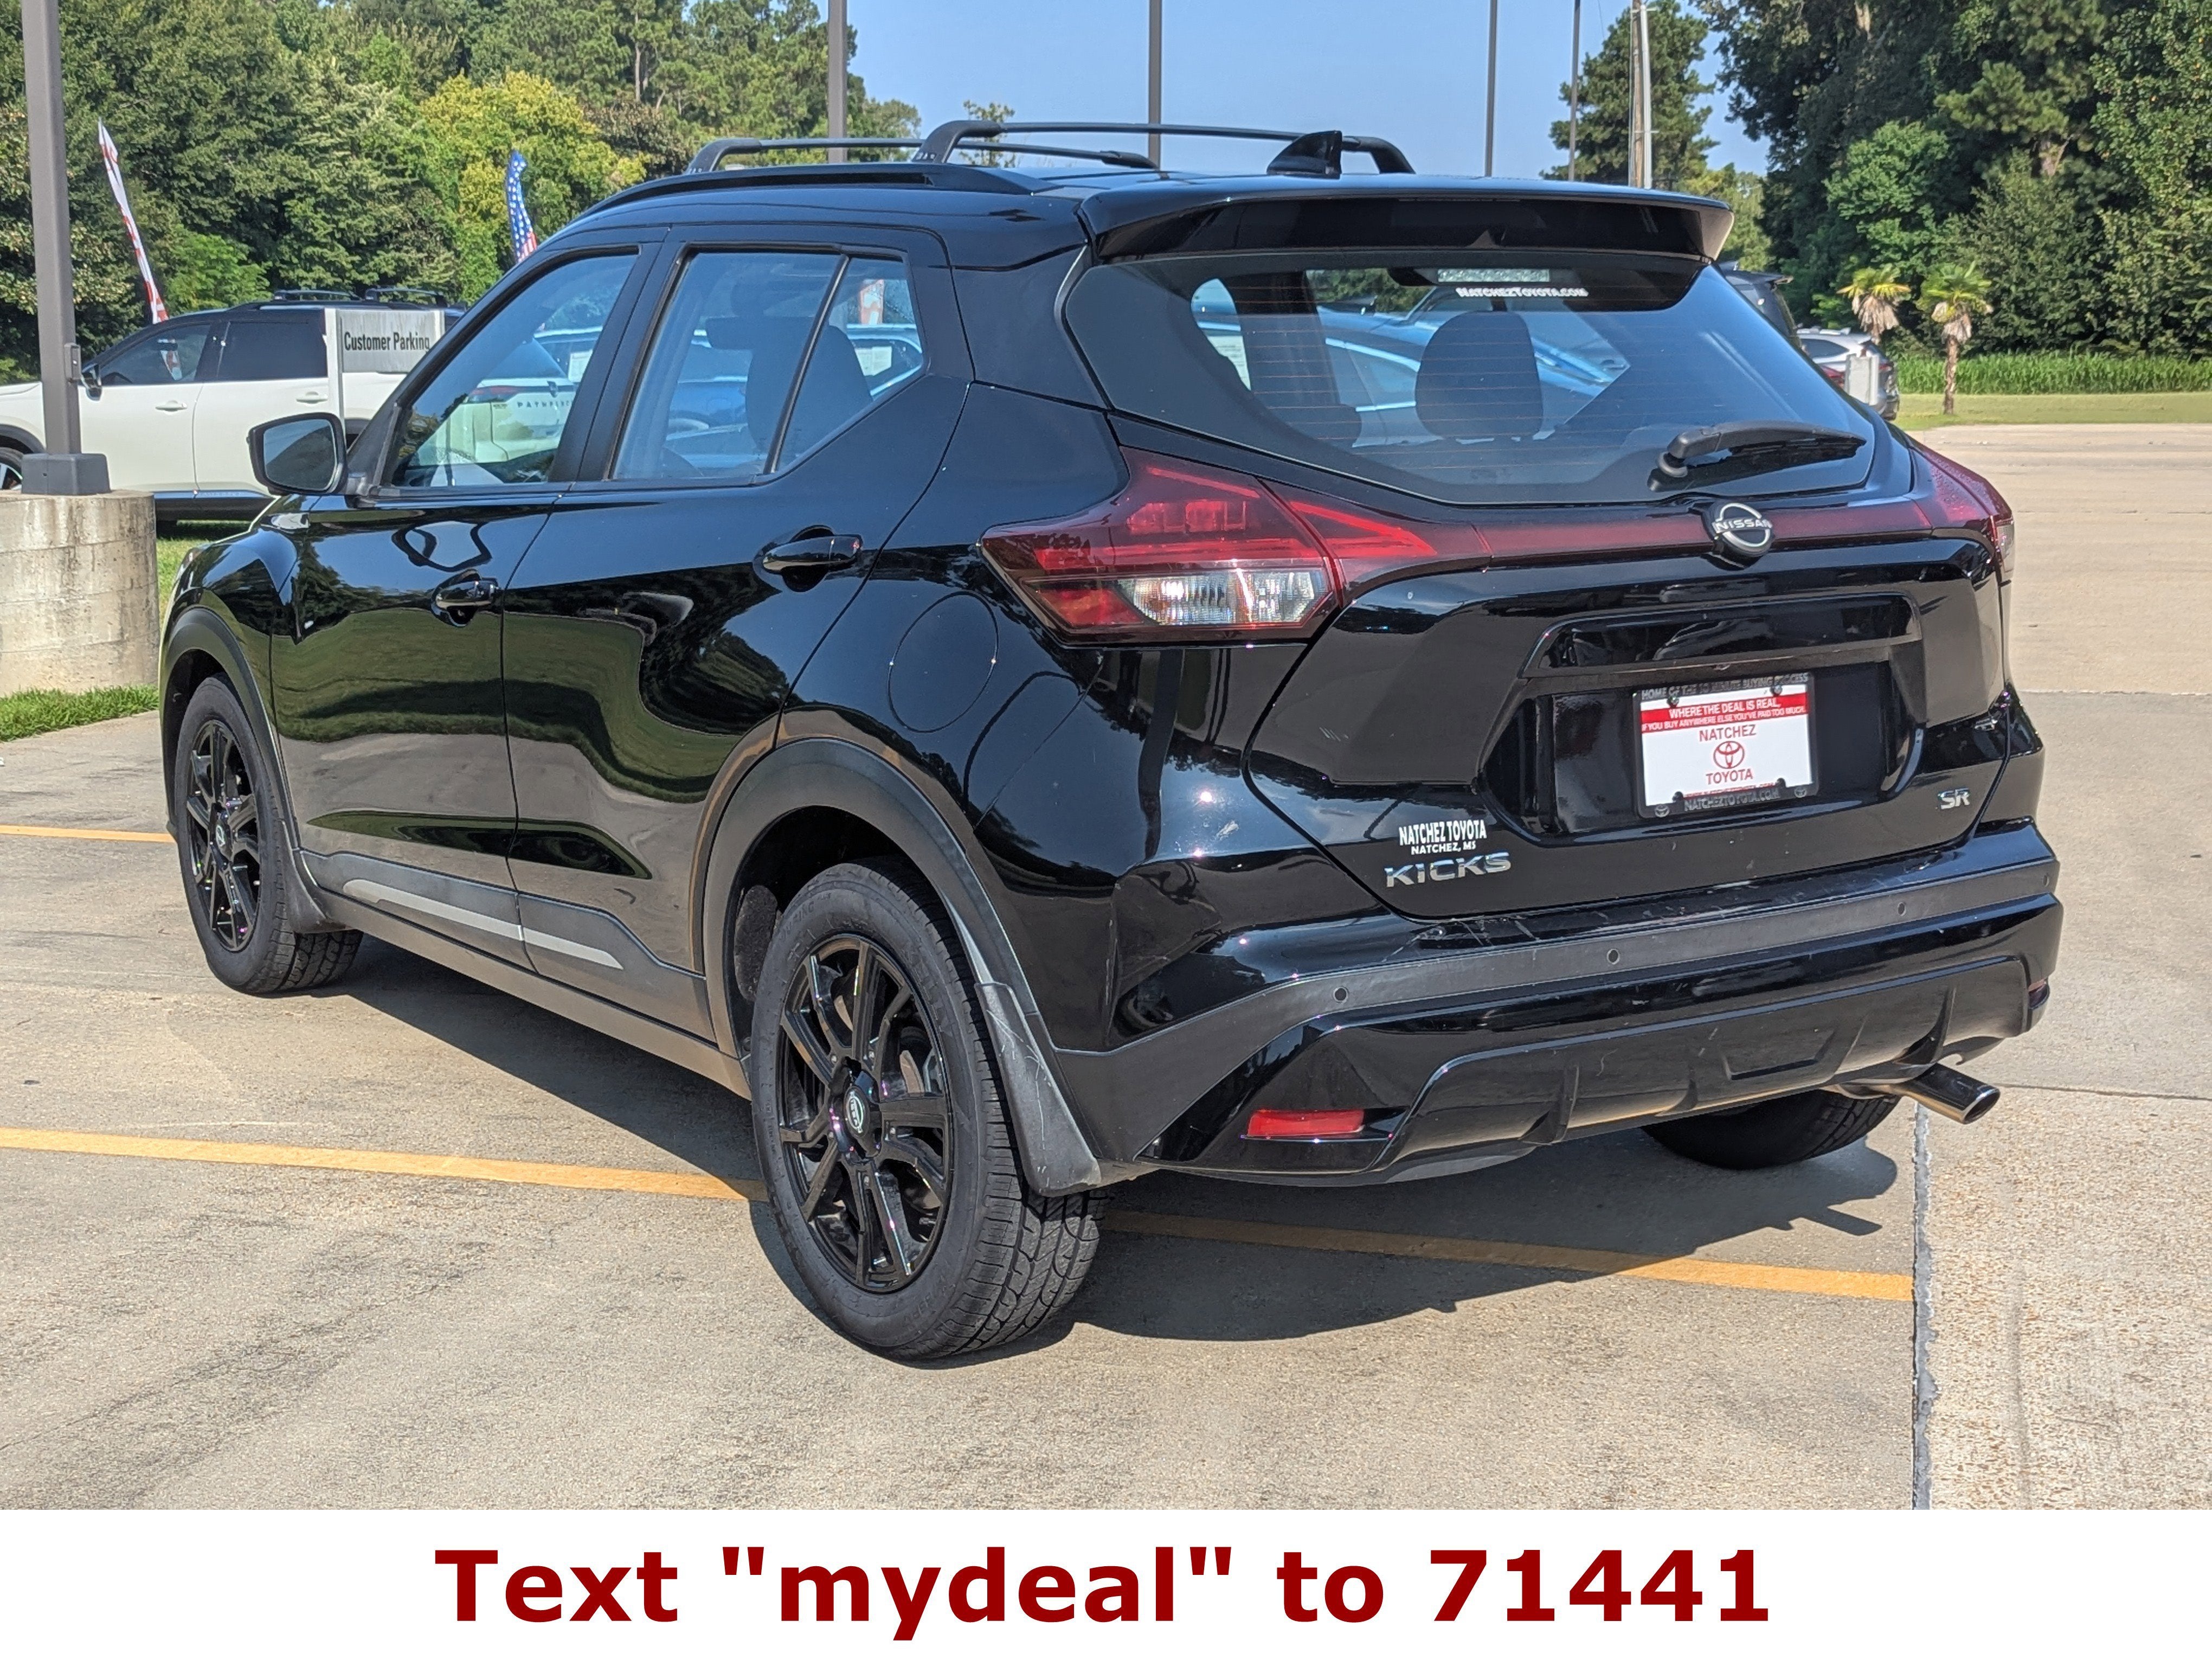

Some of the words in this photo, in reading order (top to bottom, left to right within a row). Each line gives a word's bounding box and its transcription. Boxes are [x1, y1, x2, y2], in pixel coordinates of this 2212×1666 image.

[344, 331, 391, 350] Customer
[393, 331, 430, 353] Parking
[1714, 518, 1772, 533] NISSAN
[1642, 687, 1667, 700] HOME
[1743, 676, 1773, 689] BUYING
[1642, 723, 1648, 732] IF
[1648, 722, 1663, 731] YOU
[1664, 720, 1679, 729] BUY
[1679, 715, 1716, 727] ANYWHERE
[1717, 714, 1734, 723] ELSE
[1734, 711, 1757, 721] YOU'VE
[1758, 709, 1771, 719] PAID
[1771, 708, 1785, 716] TOO
[1669, 707, 1703, 719] WHERE
[1703, 704, 1720, 715] THE
[1721, 702, 1745, 714] DEAL
[1746, 700, 1755, 710] IS
[1699, 724, 1757, 741] NATCHEZ
[1706, 768, 1753, 785] TOYOTA
[1937, 788, 1970, 810] SR
[1399, 821, 1446, 845] NATCHEZ
[1446, 819, 1487, 841] TOYOTA
[1411, 842, 1461, 855] NATCHEZ,
[1463, 841, 1477, 850] MS
[1384, 852, 1511, 887] KICKS
